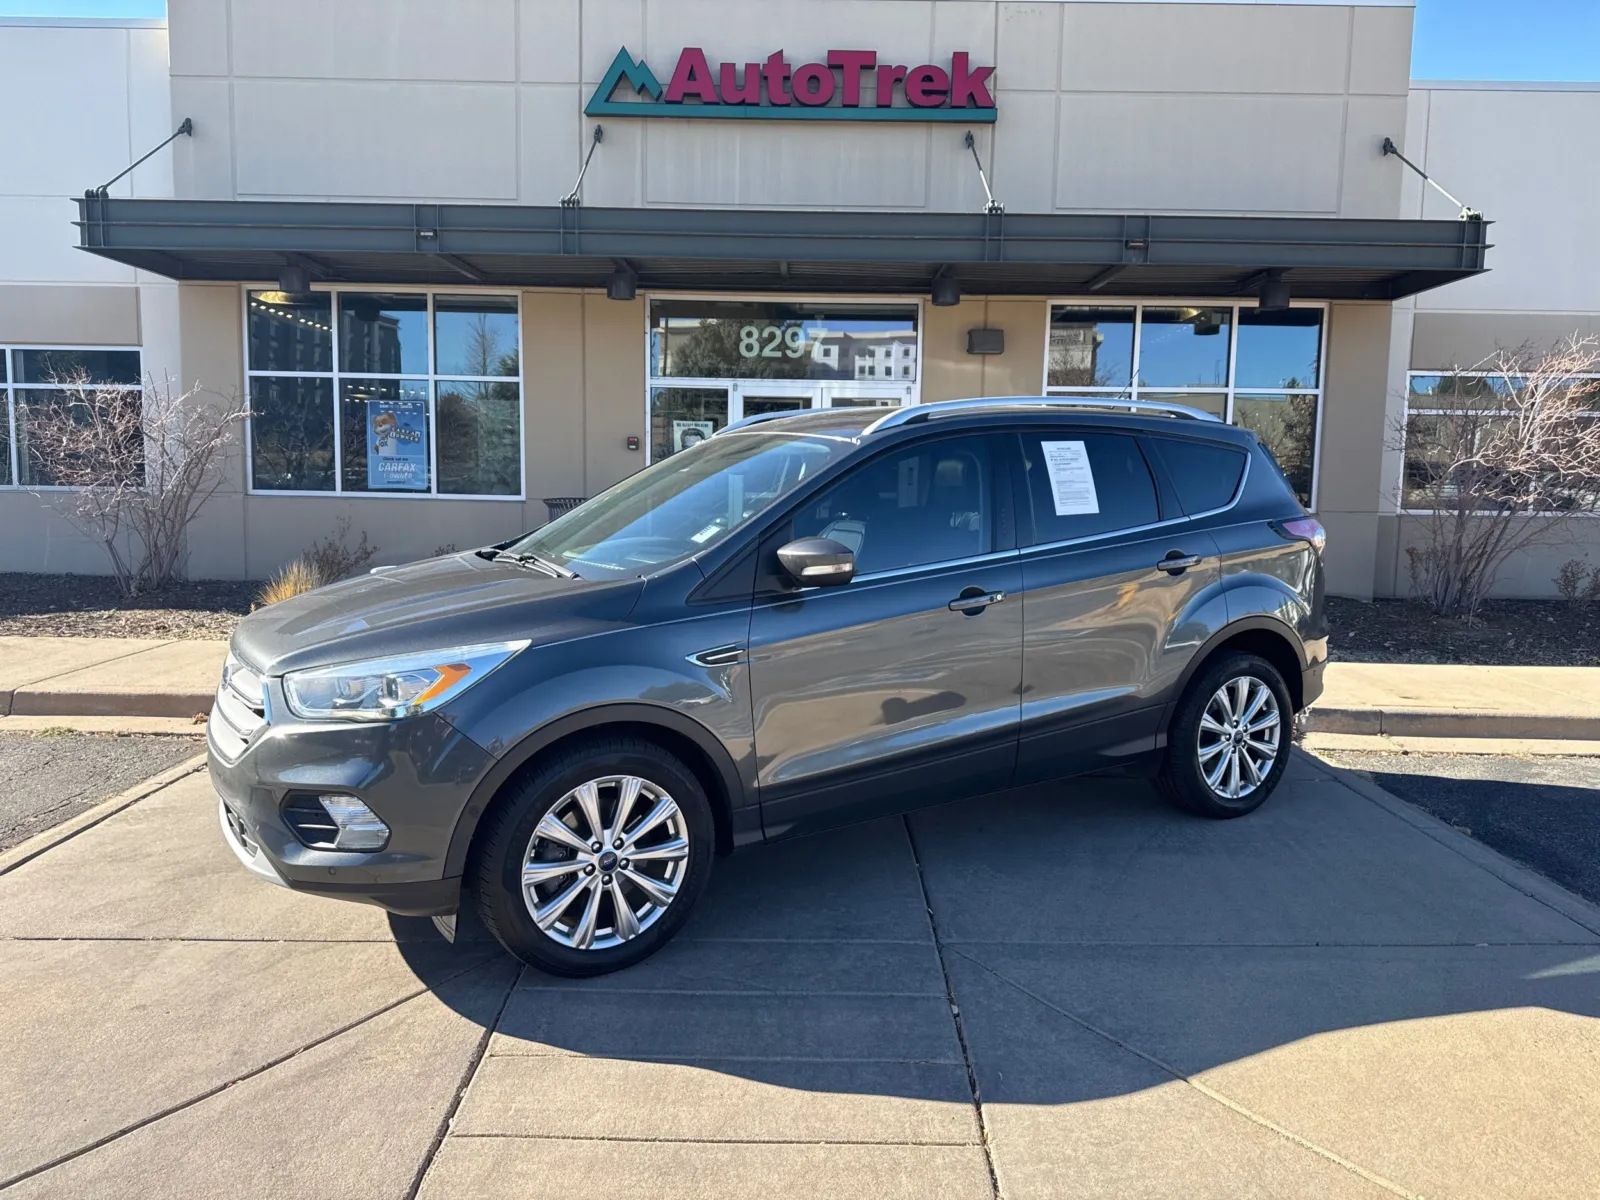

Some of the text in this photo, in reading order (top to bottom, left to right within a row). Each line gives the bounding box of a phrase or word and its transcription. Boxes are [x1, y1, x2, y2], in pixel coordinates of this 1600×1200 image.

[664, 47, 997, 108] AutoTrek
[739, 326, 829, 358] 8297
[378, 462, 416, 472] CARFAX
